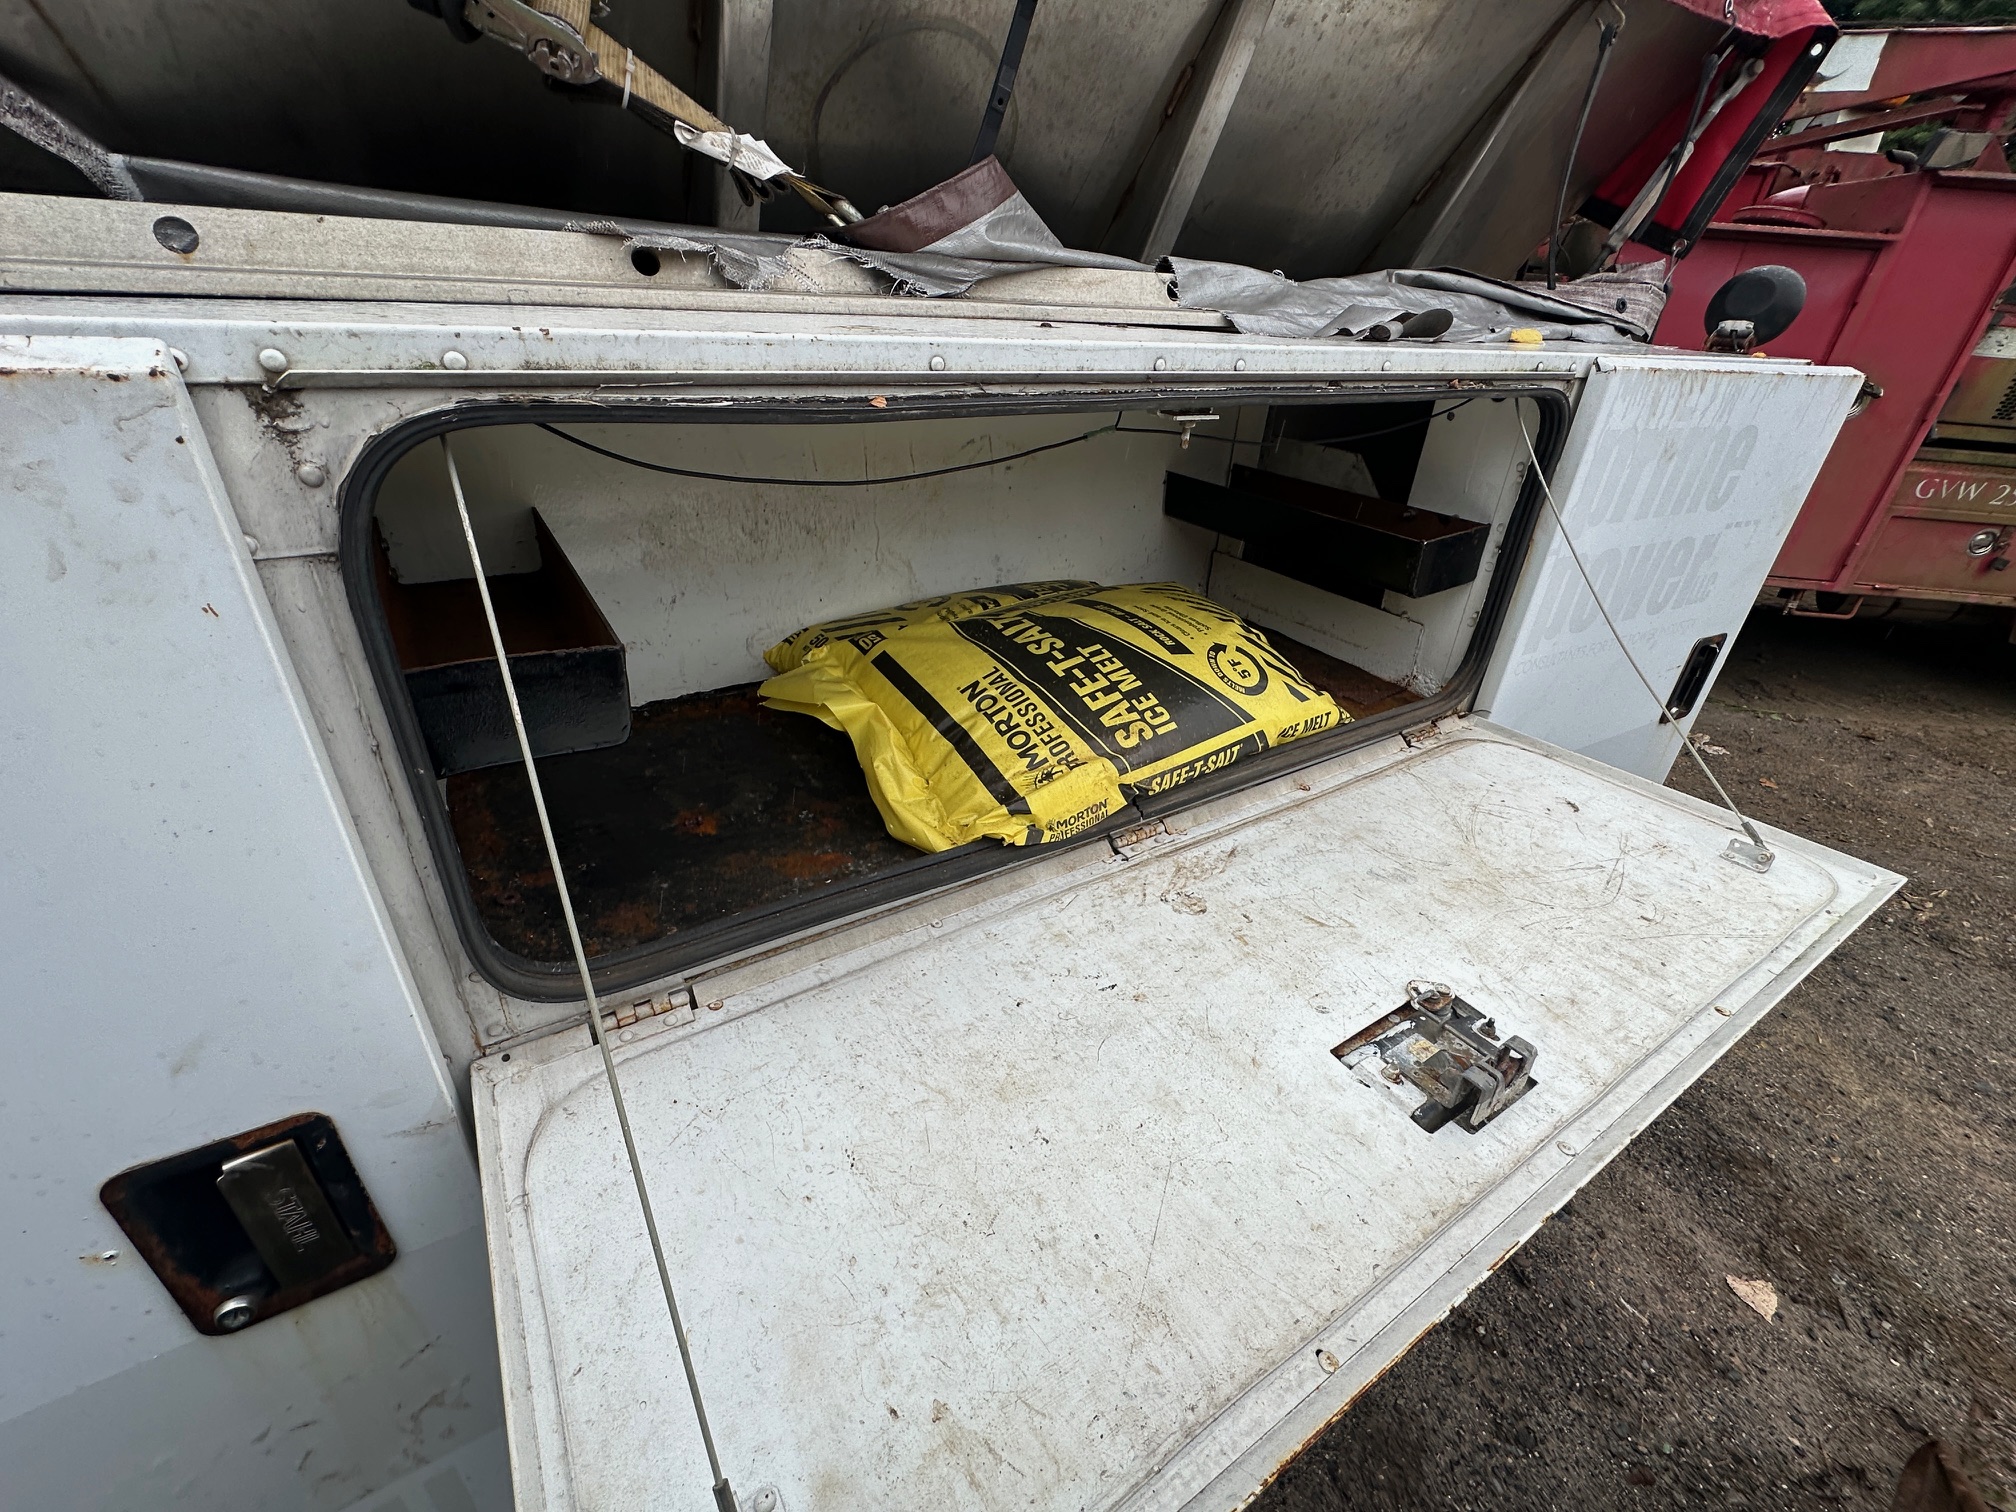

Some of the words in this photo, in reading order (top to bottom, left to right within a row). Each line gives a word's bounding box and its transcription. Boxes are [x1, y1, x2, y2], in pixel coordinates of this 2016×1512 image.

[1915, 478, 1989, 500] GVW
[858, 634, 882, 651] 50
[1149, 629, 1176, 646] ROCK
[985, 611, 1154, 749] SAFE-T-SALT
[1076, 643, 1143, 693] MELT
[959, 680, 1049, 772] MORTON
[1132, 692, 1178, 736] ICE
[1147, 744, 1243, 796] SAFE-T-SALT
[1301, 711, 1332, 735] MELT
[1056, 798, 1109, 830] MORTON
